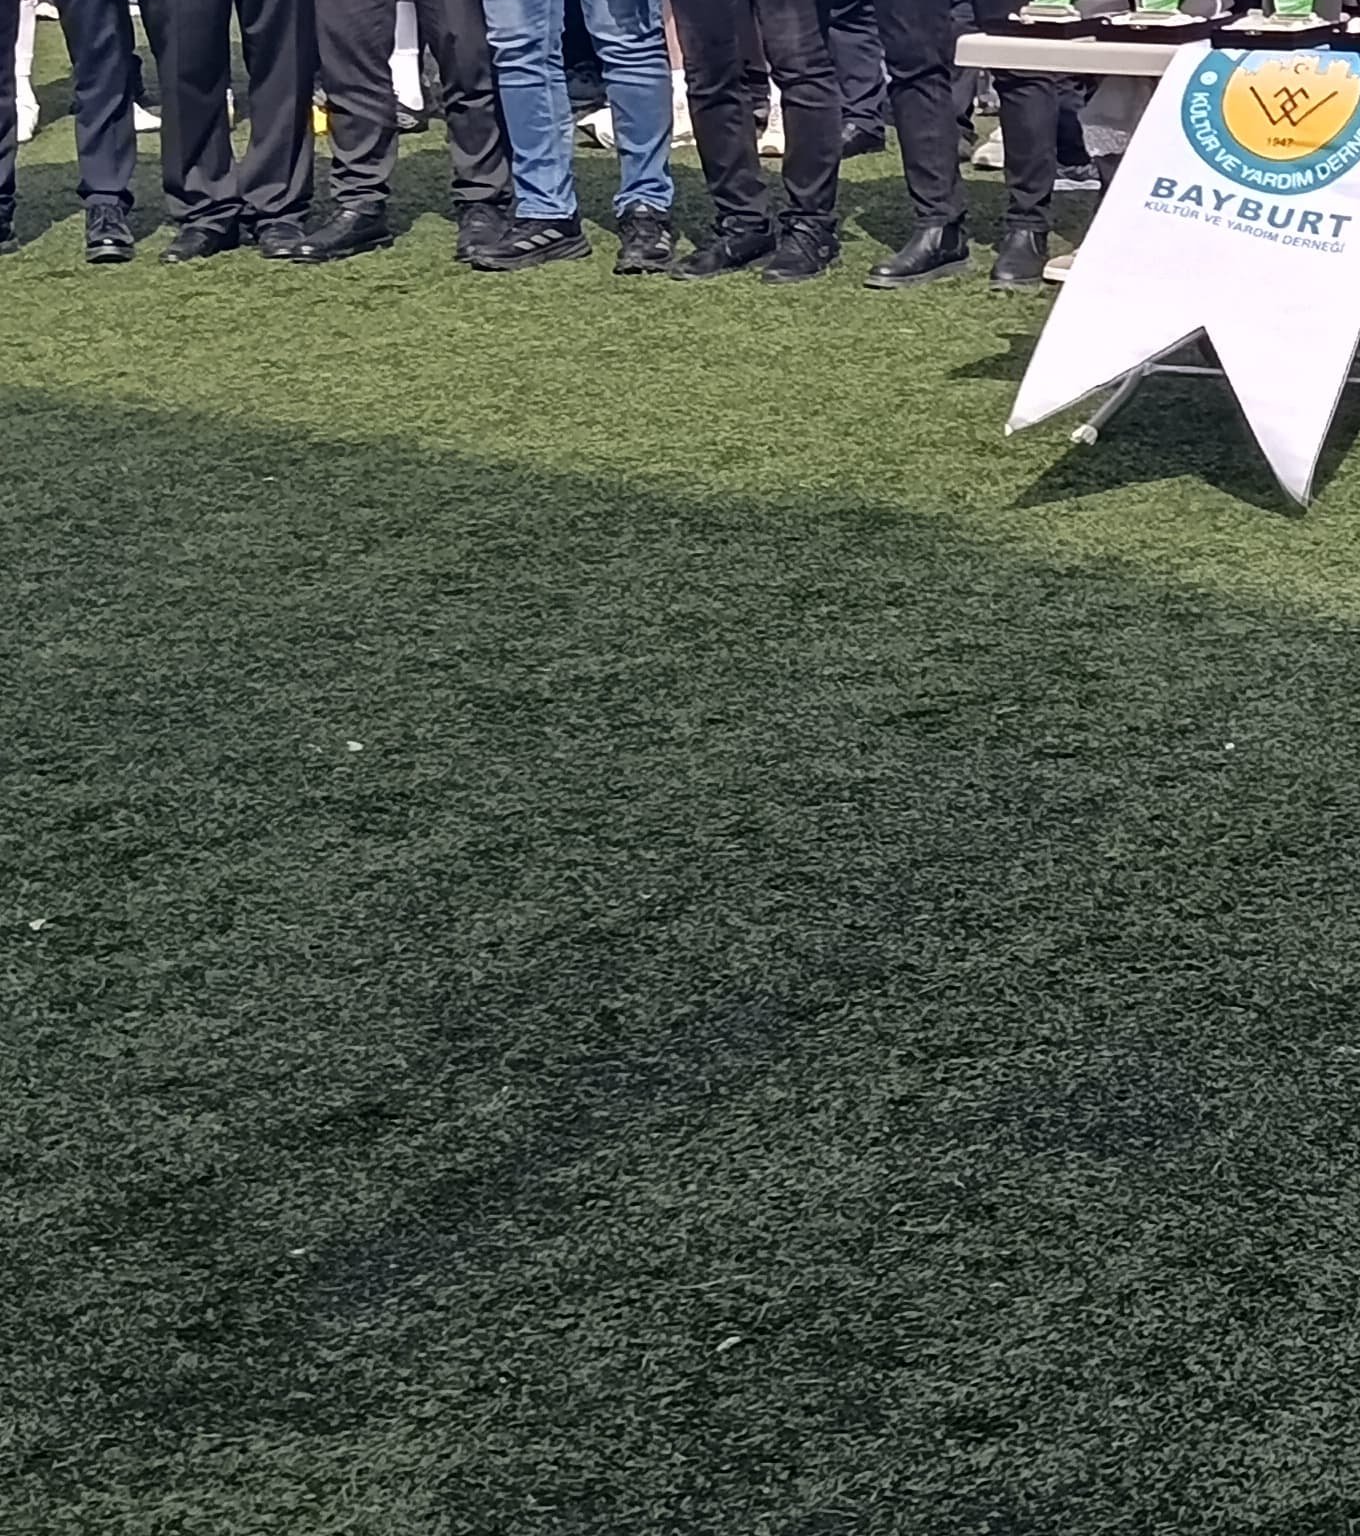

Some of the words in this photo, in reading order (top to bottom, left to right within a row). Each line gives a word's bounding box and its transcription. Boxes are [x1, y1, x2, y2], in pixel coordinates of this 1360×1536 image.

[1188, 92, 1221, 152] KÜLTÜR
[1214, 148, 1242, 173] VE
[1239, 163, 1314, 190] YARDIM
[1144, 200, 1200, 220] KÜLTÜR
[1204, 213, 1222, 226] VE
[1227, 220, 1280, 242] YARDIM
[1282, 234, 1346, 254] DERNEĞİ
[1149, 176, 1353, 238] BAYBURT
